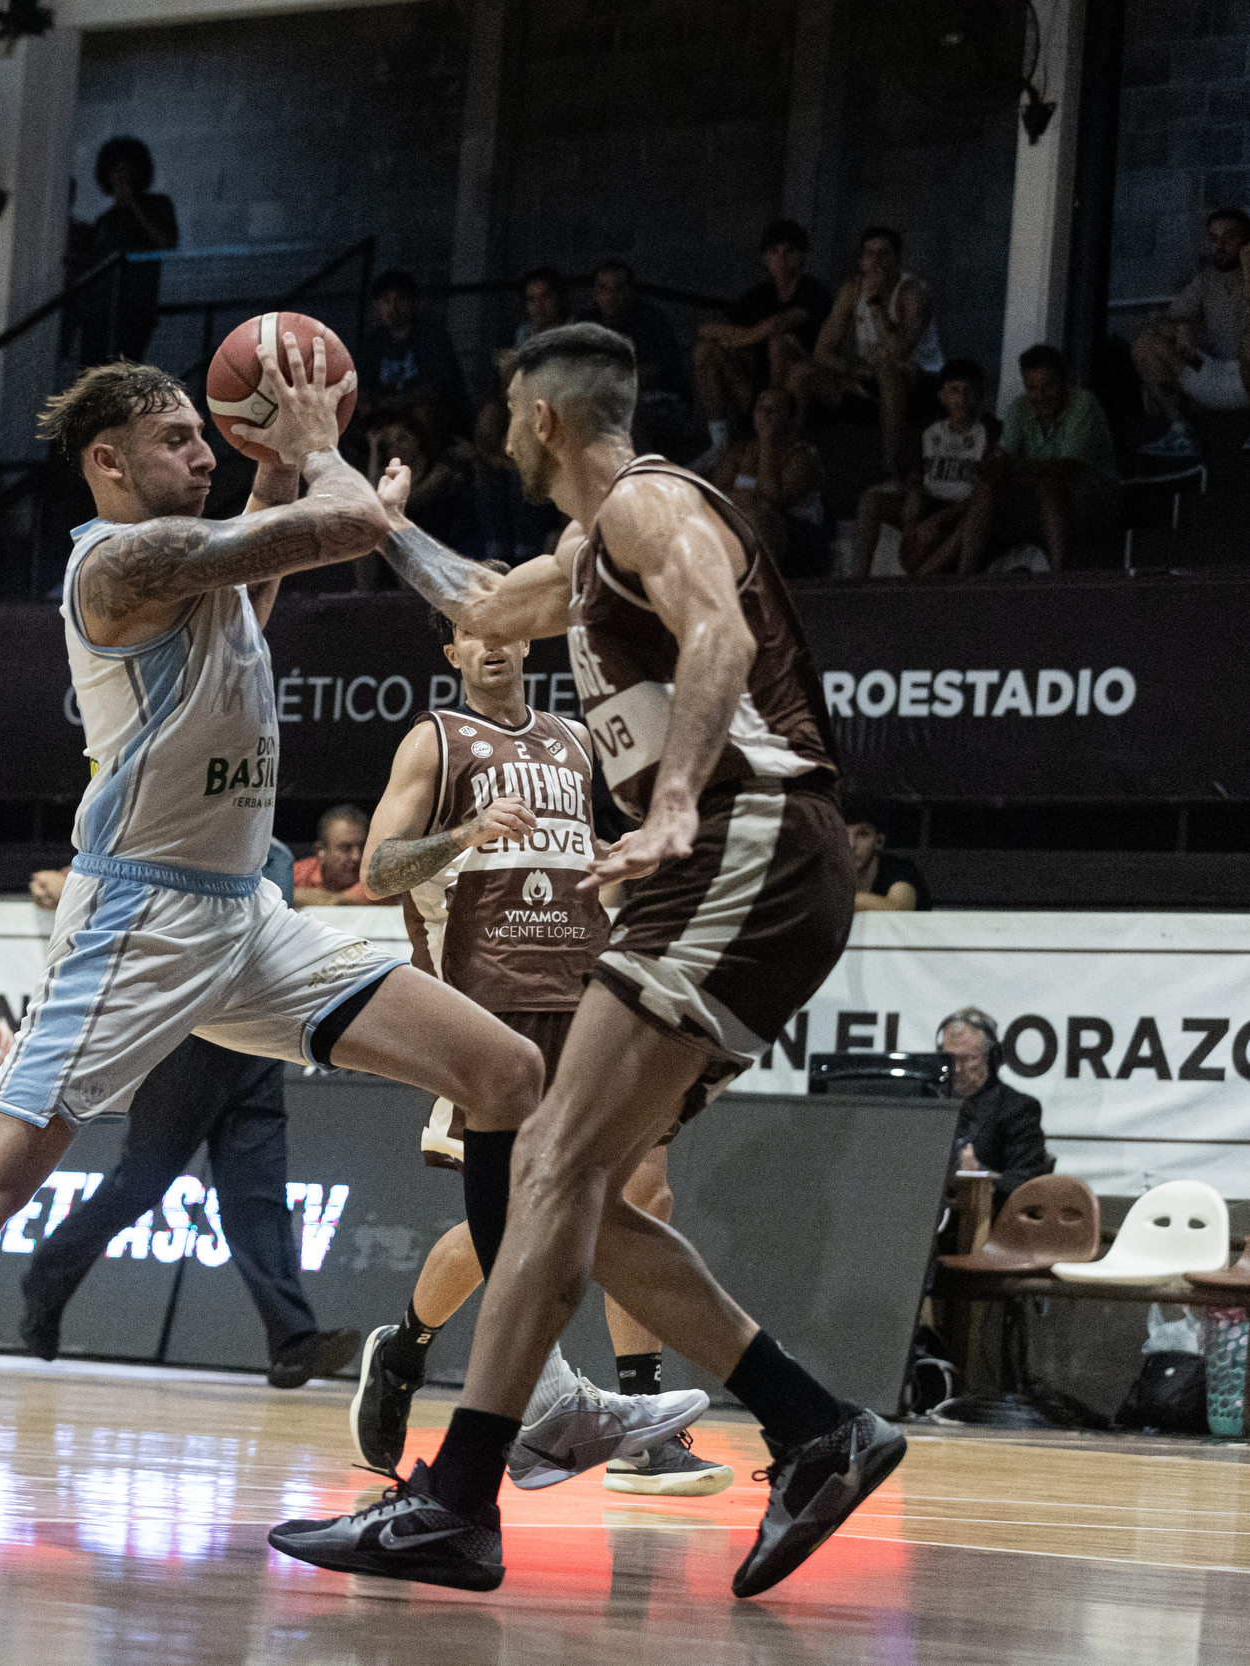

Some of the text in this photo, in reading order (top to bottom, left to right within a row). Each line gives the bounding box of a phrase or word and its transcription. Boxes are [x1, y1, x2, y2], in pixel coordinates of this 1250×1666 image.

[277, 667, 413, 723] ÉTICO
[822, 666, 1138, 718] ROESTADIO
[513, 740, 531, 760] 2
[550, 741, 562, 756] CAP
[204, 757, 275, 797] BASIL
[505, 910, 569, 924] VIVAMOS
[484, 923, 586, 939] VICENTE LÓPEZ
[759, 1011, 810, 1071] N
[1004, 1014, 1250, 1082] ORAZ
[416, 1333, 432, 1344] 2
